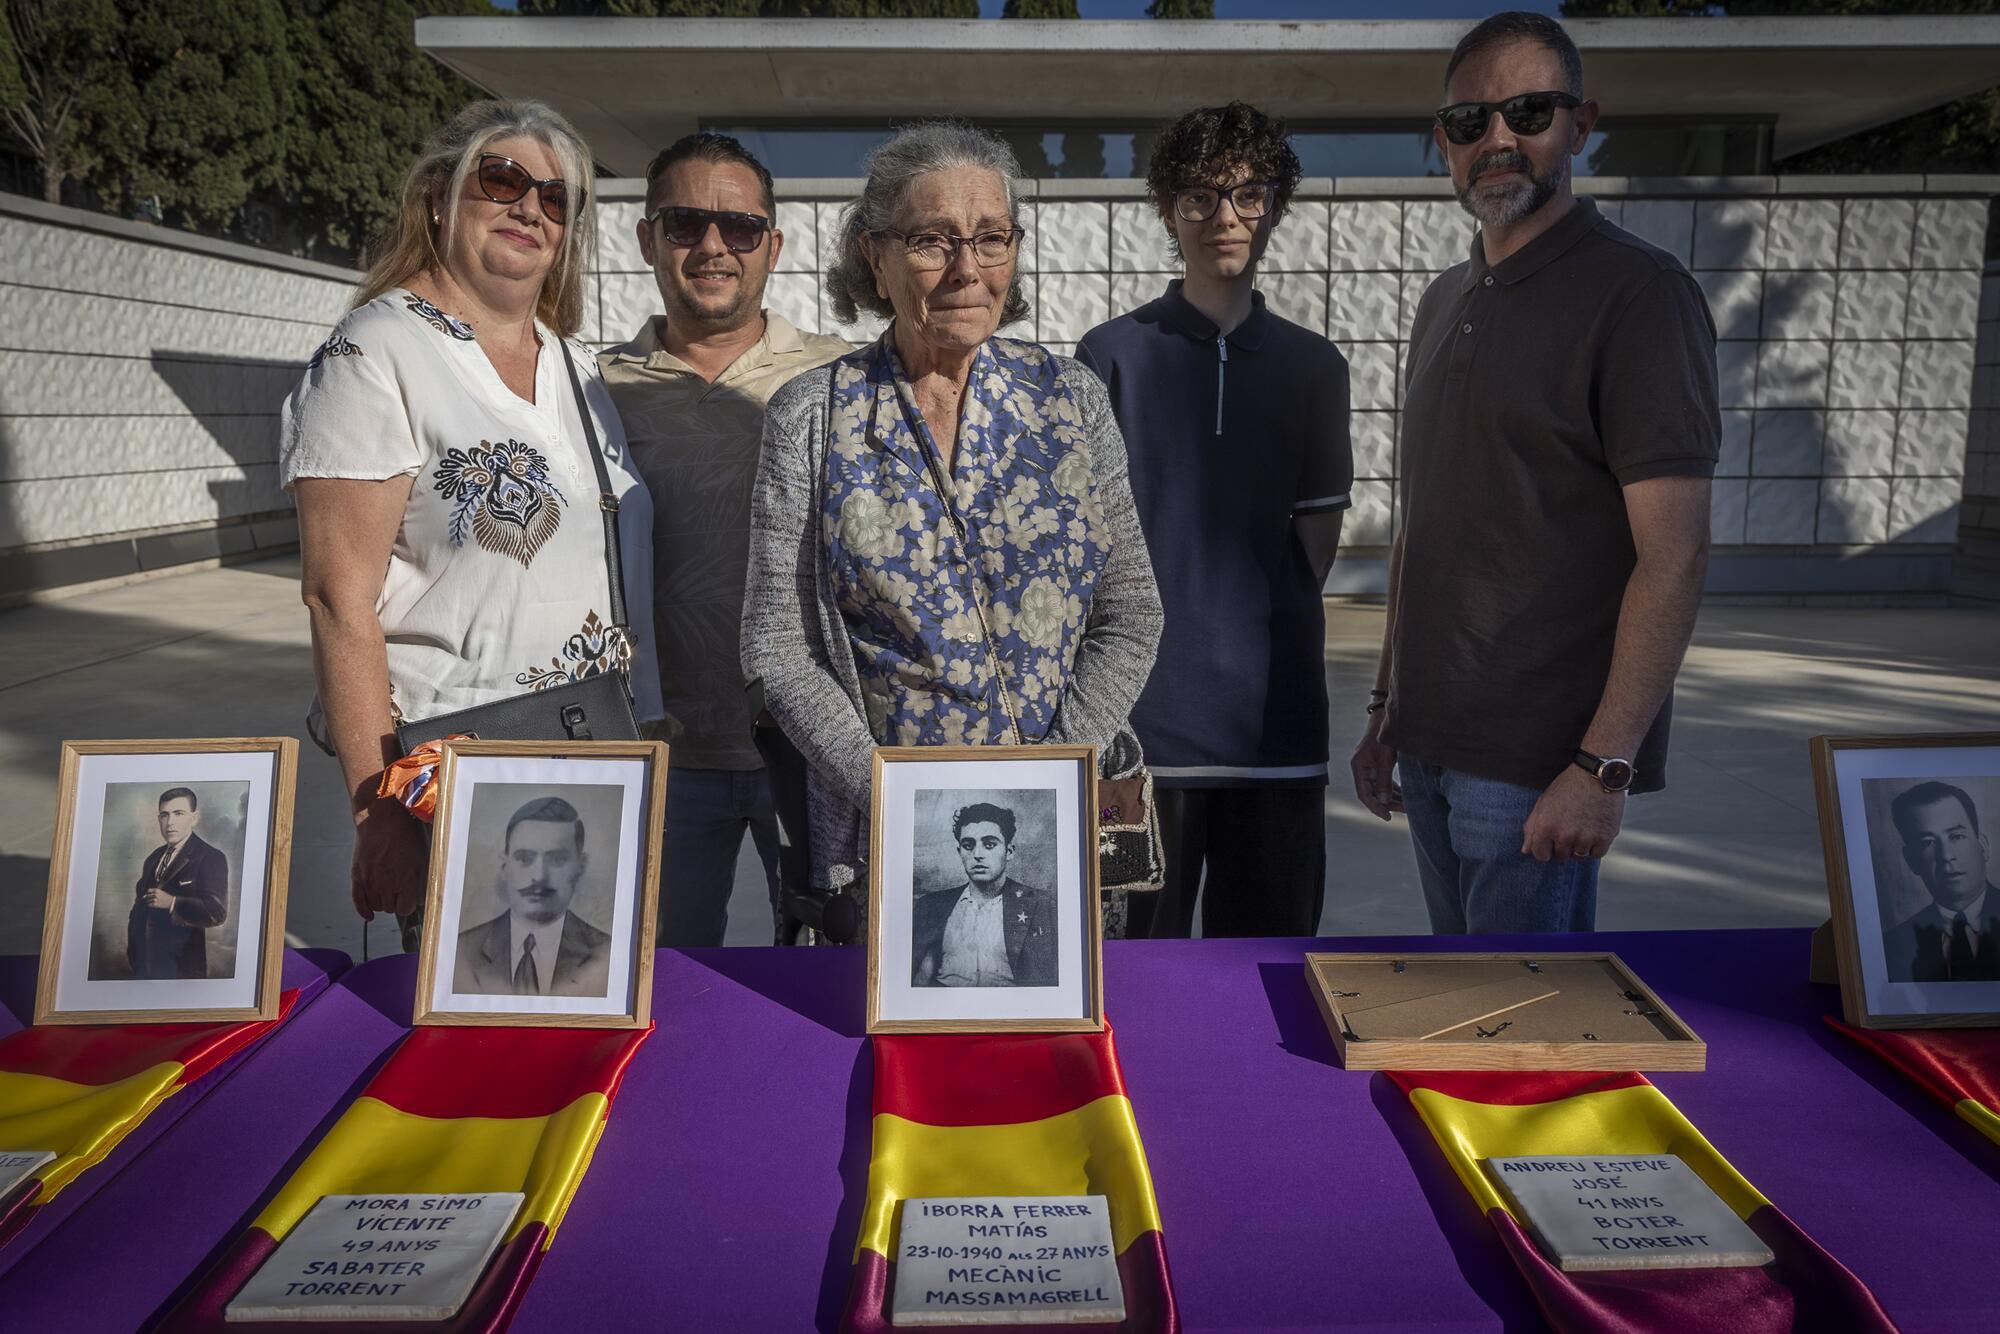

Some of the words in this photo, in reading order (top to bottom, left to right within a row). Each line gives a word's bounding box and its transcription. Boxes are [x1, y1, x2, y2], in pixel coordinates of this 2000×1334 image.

[1502, 1162, 1587, 1173] ANDREU
[1593, 1160, 1672, 1173] ESTEVE
[1572, 1176, 1628, 1190] JOSÉ
[344, 1198, 410, 1211] MORA
[1577, 1197, 1607, 1210] 41
[1611, 1197, 1665, 1210] ANYS
[1013, 1205, 1093, 1219] FERRER
[968, 1221, 1048, 1238] MATÍAS
[1592, 1215, 1685, 1230] BOTER
[341, 1239, 375, 1253] 49
[376, 1239, 441, 1253] ANYS
[1591, 1235, 1710, 1251] TORRENT
[905, 1245, 1003, 1260] 23-10-1940
[1035, 1247, 1060, 1261] 27
[1062, 1245, 1110, 1260] ANYS
[302, 1261, 426, 1277] SABATER
[284, 1281, 407, 1297] TORRENT
[925, 1287, 1110, 1306] MASSAMAGRELL
